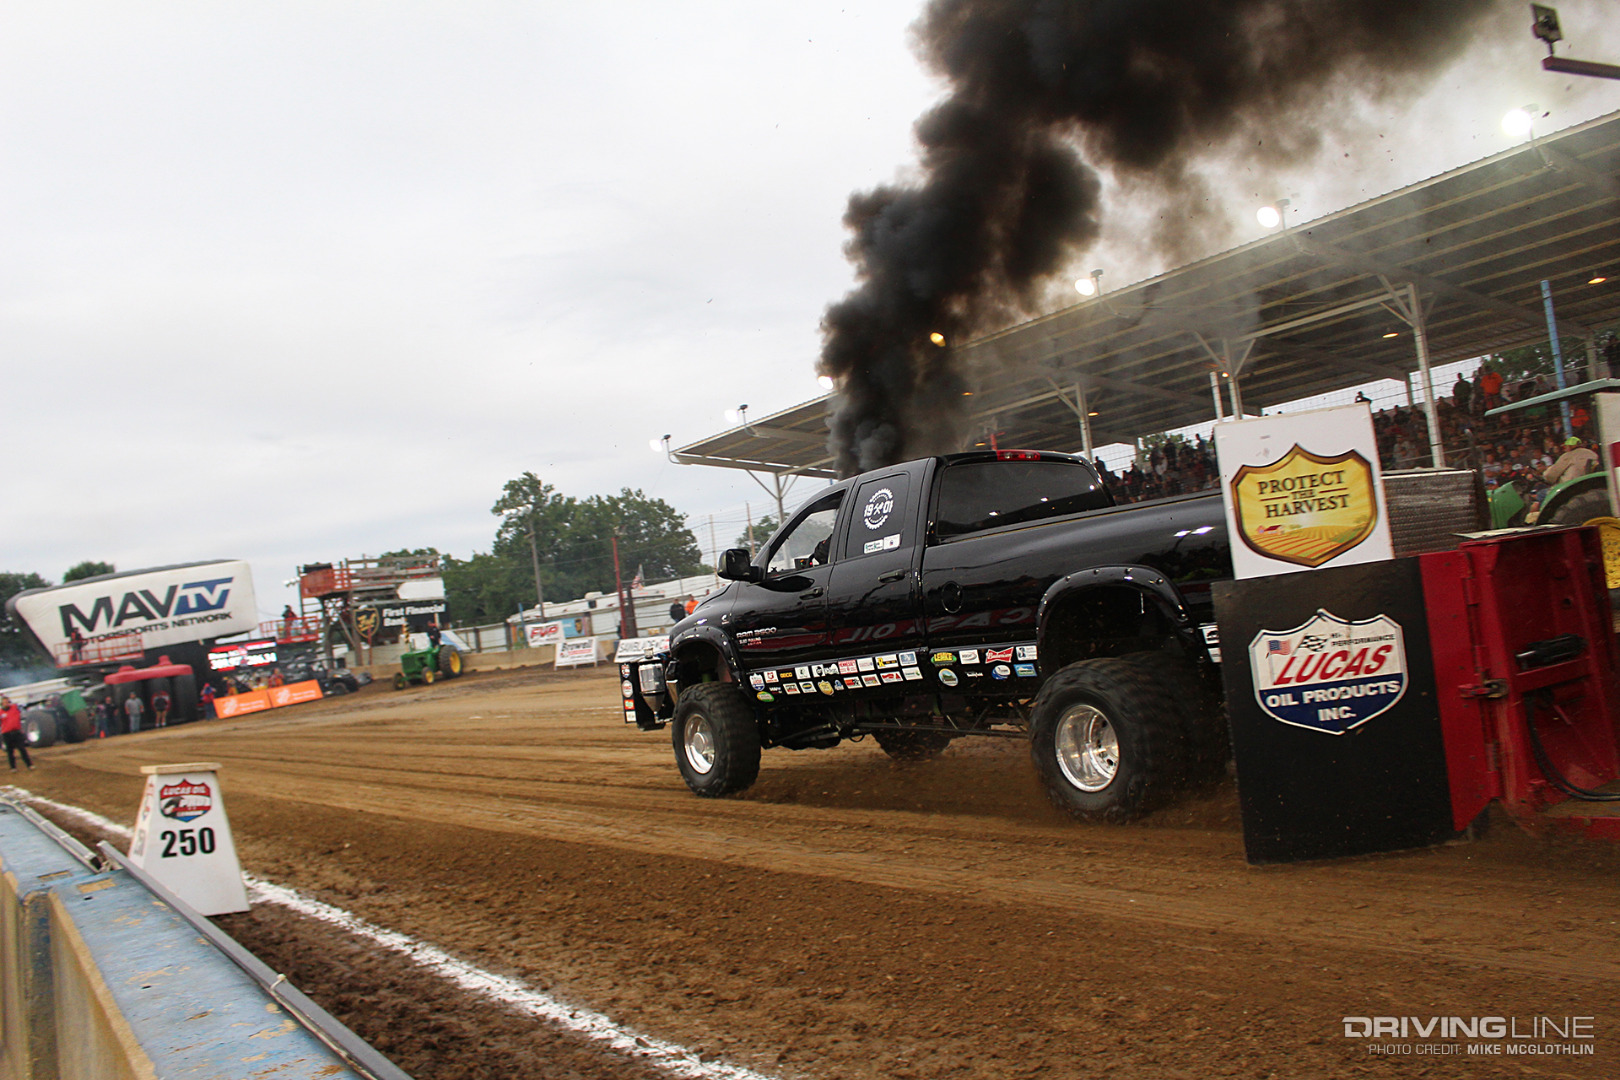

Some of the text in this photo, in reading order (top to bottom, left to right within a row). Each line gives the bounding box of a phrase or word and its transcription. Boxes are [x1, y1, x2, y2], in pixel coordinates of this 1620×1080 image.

[1257, 470, 1345, 495] PROTECT
[1290, 489, 1316, 500] THE
[1265, 494, 1349, 518] HARVEST
[172, 612, 232, 628] NETWORK
[1273, 645, 1393, 686] LUCAS
[1265, 680, 1401, 708] OIL PRODUCTS
[1317, 706, 1357, 722] INC.
[163, 785, 206, 796] LUCAS OIL
[161, 827, 216, 858] 250
